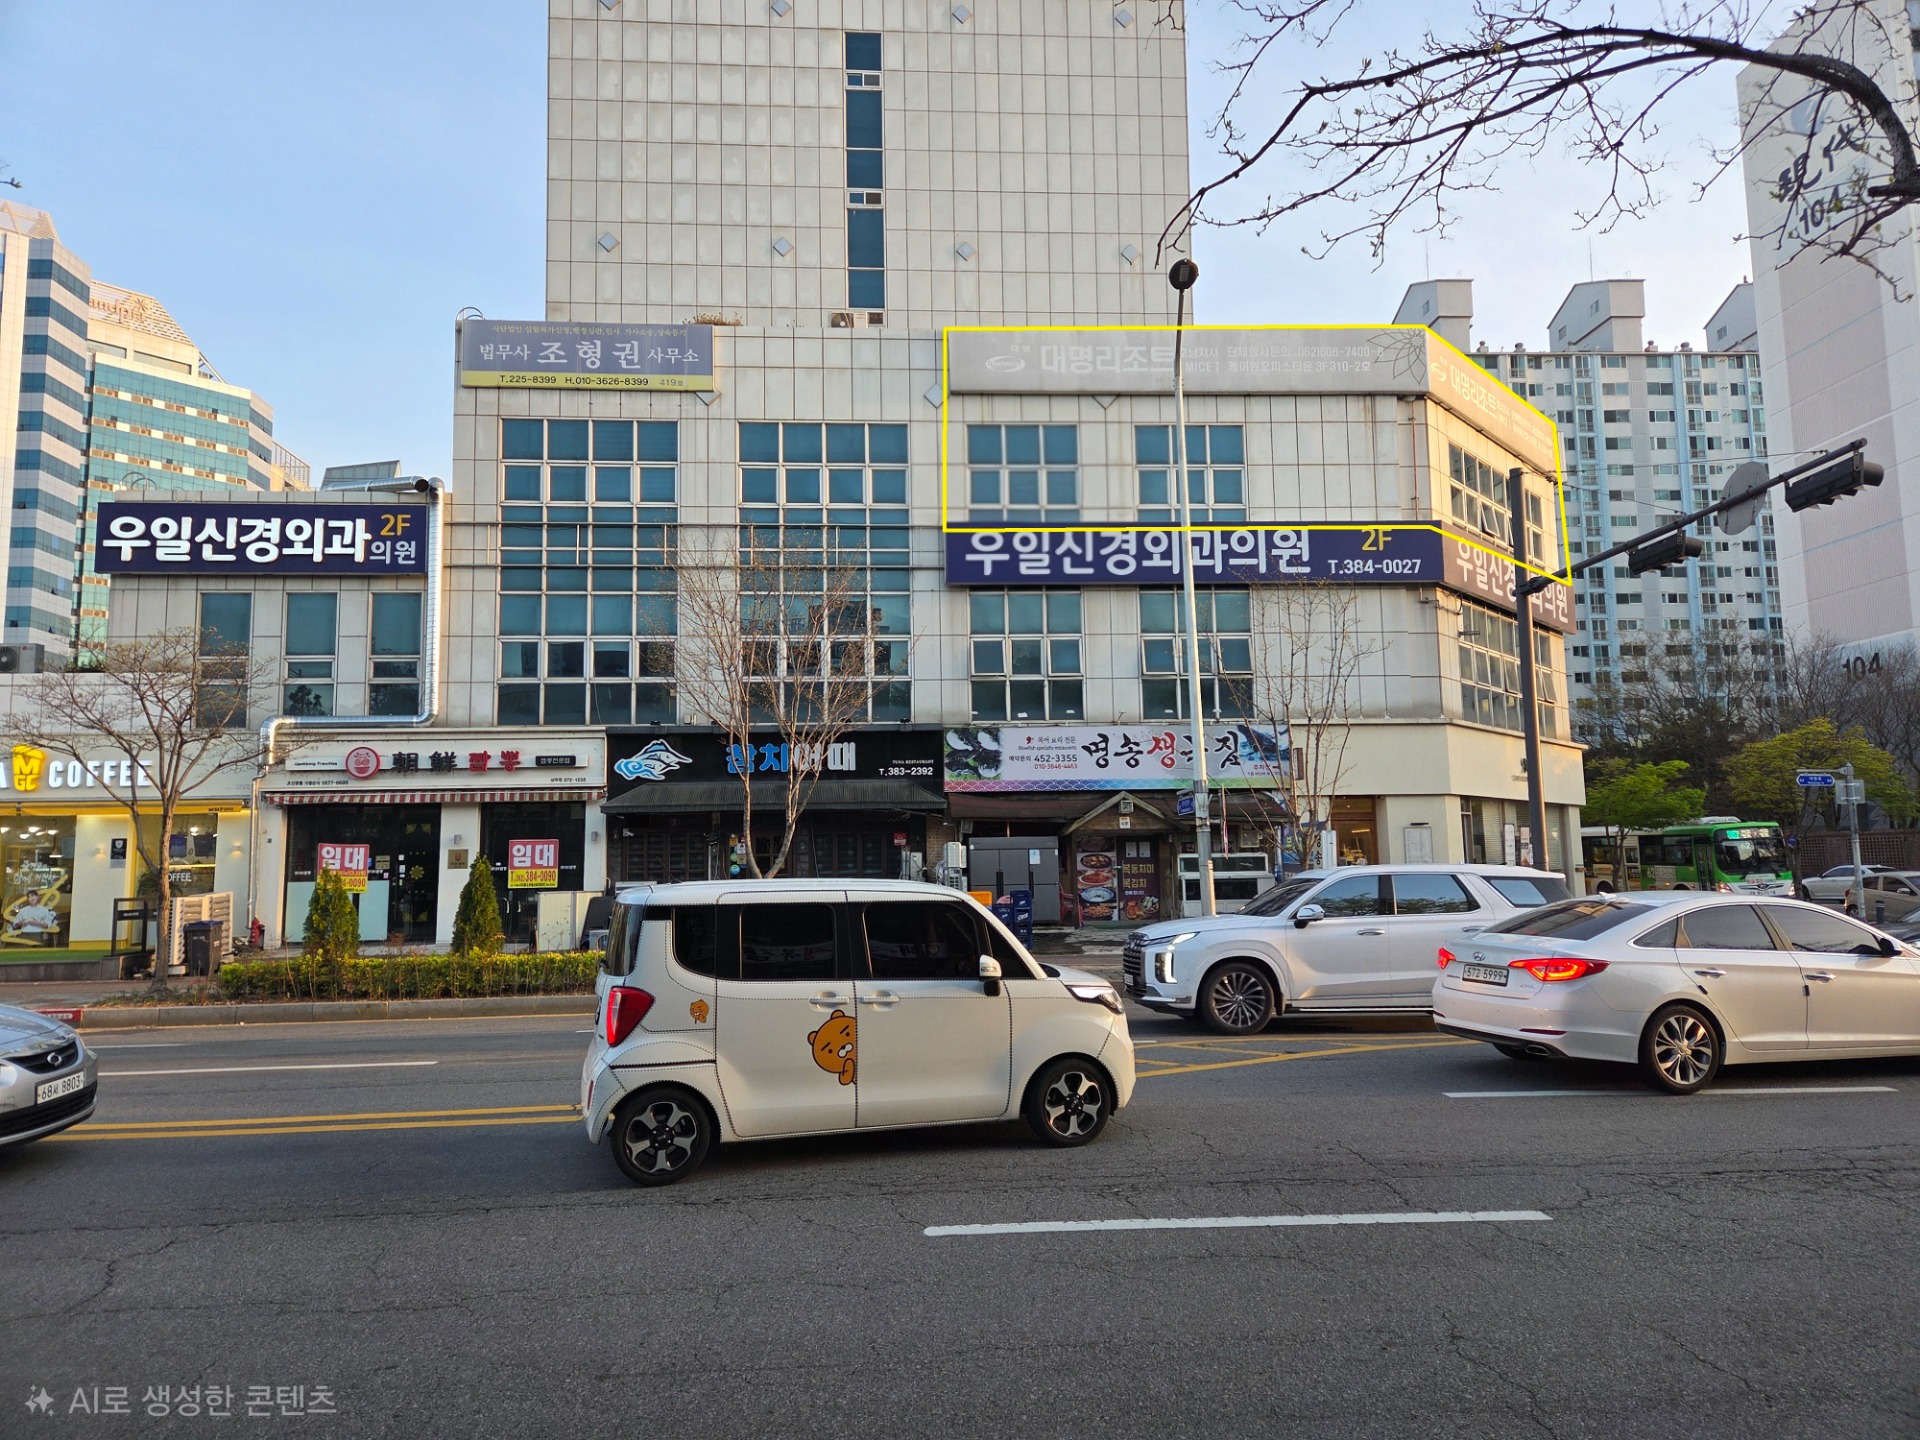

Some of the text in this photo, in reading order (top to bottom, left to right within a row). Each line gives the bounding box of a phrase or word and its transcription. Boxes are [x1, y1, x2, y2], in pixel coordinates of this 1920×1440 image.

[480, 344, 530, 361] 법무사
[647, 347, 699, 364] 사무소
[1041, 345, 1175, 374] 대명리조트
[1316, 362, 1327, 372] 3F
[1330, 362, 1372, 372] 310-2호
[500, 375, 684, 387] T.225-8399 H.010-3626-8399 419호
[1450, 363, 1498, 419] 대명리조트
[102, 514, 411, 563] 우일신경외과 2F
[369, 540, 416, 565] 의원
[965, 528, 1393, 576] 우일신경외과의원 2F
[1328, 558, 1422, 575] T.384-0027
[1843, 652, 1883, 681] 104
[1051, 736, 1062, 744] 요리
[1064, 736, 1076, 744] 전문
[1034, 754, 1078, 762] 452-3355
[48, 760, 153, 788] COFFEE
[878, 767, 934, 776] T.383-2392
[322, 846, 364, 870] 임대
[512, 844, 554, 866] 임대
[1123, 864, 1154, 874] 복동치미
[1123, 878, 1146, 888] 복김치
[1483, 969, 1503, 981] 5999
[62, 1076, 80, 1093] 8803
